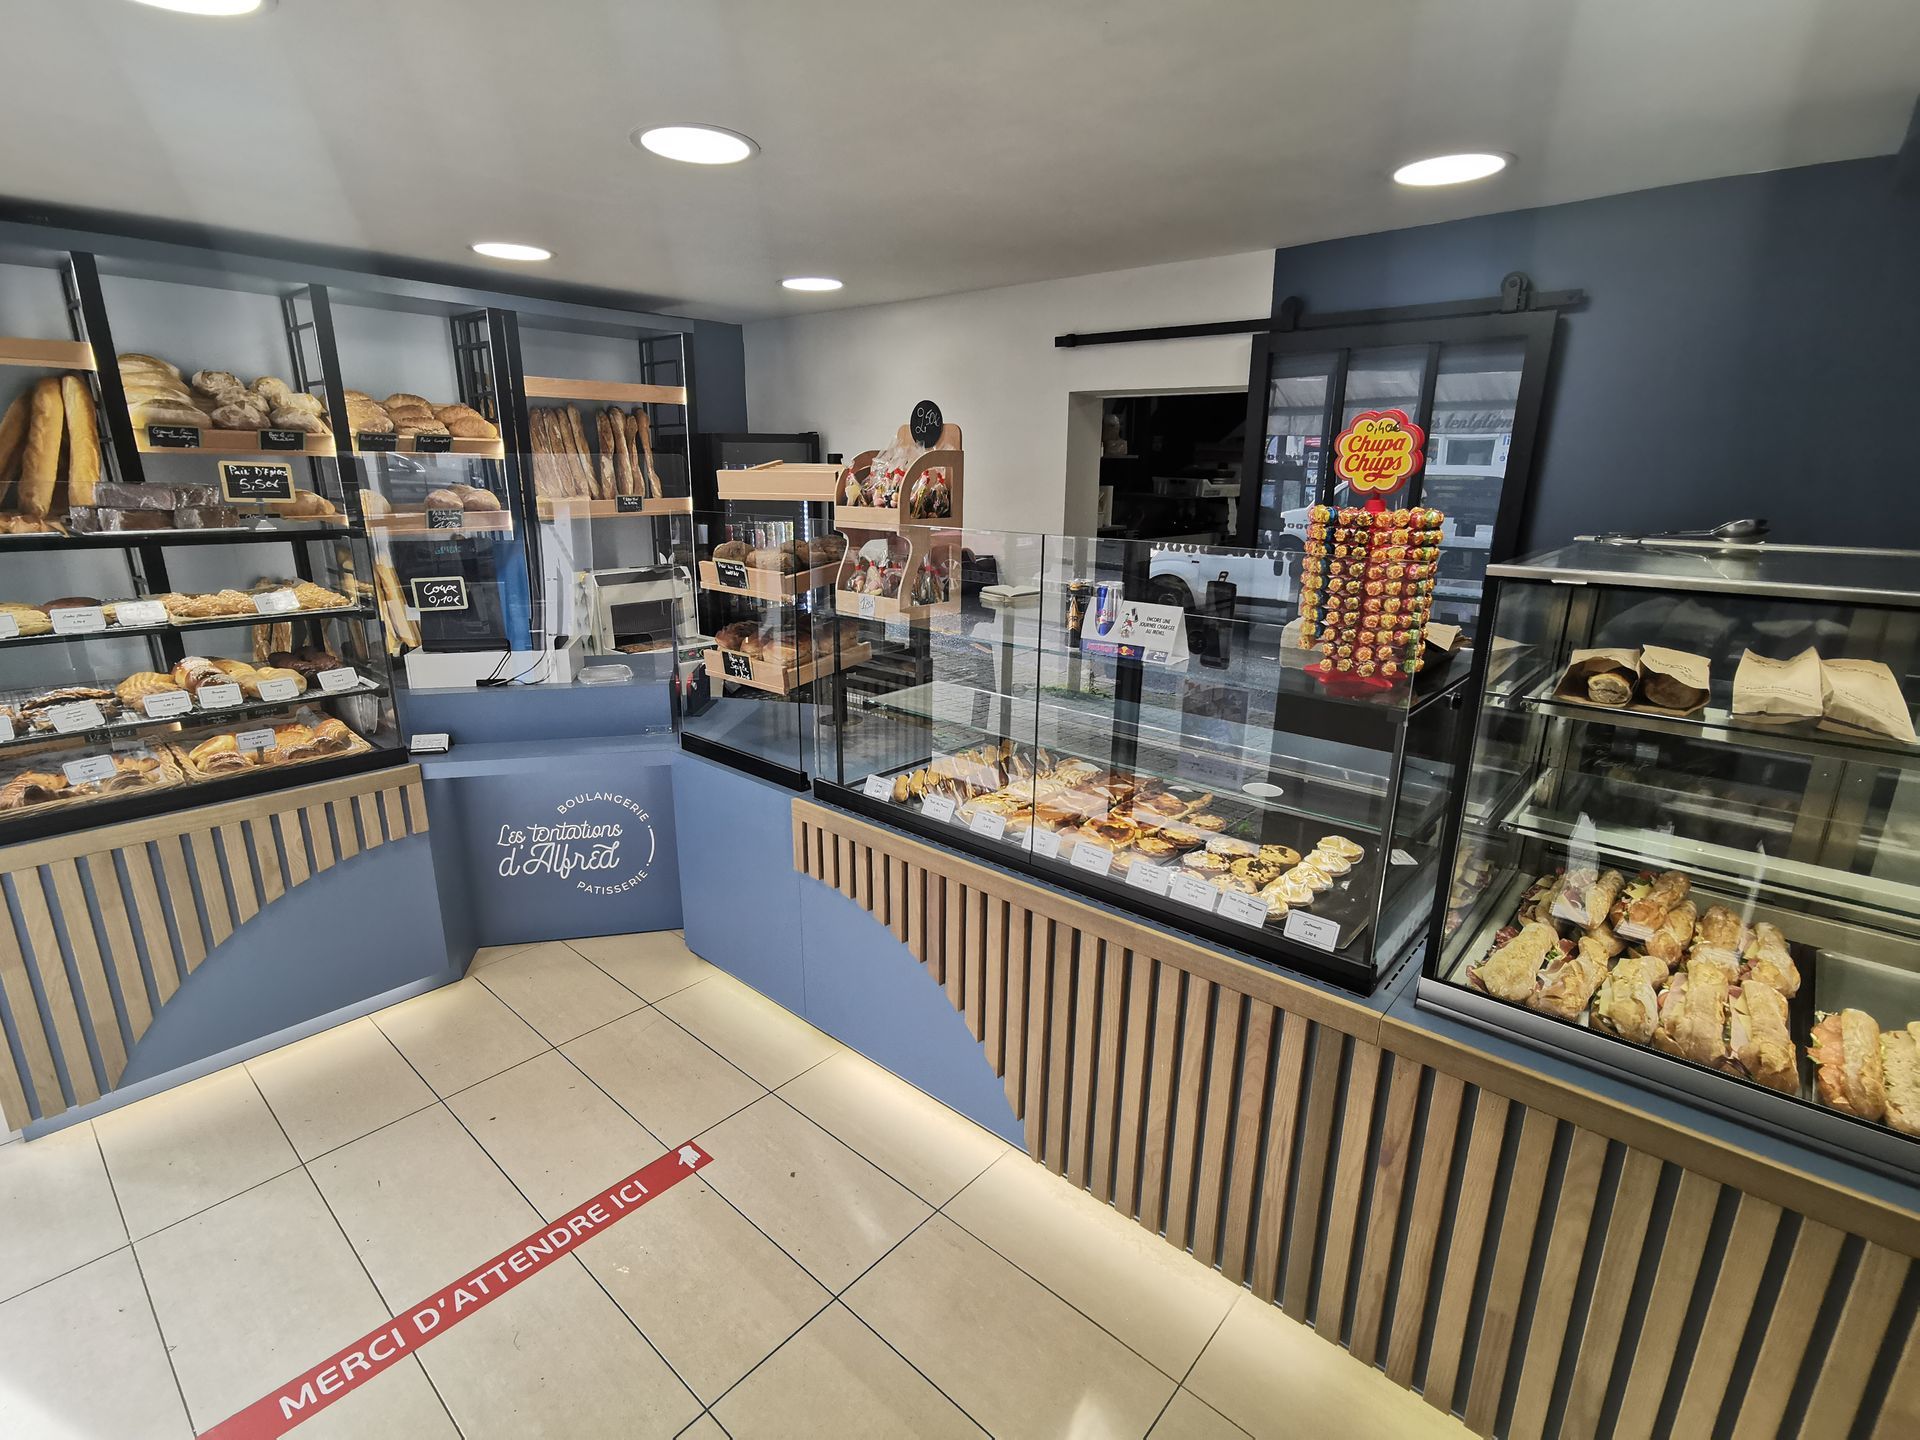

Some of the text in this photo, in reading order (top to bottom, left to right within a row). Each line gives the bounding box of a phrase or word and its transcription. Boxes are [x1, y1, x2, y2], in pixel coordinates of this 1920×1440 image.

[1348, 435, 1407, 457] Chupa
[1344, 453, 1404, 482] Chups
[423, 582, 459, 596] Coupe
[428, 595, 461, 608] 0,10€
[557, 791, 650, 823] BOULANGERIE
[497, 820, 624, 847] Les tentations
[498, 841, 621, 880] d'Alfred
[576, 868, 649, 896] PATISSERIE
[278, 1179, 650, 1420] MERCI D'ATTENDRE ICI
